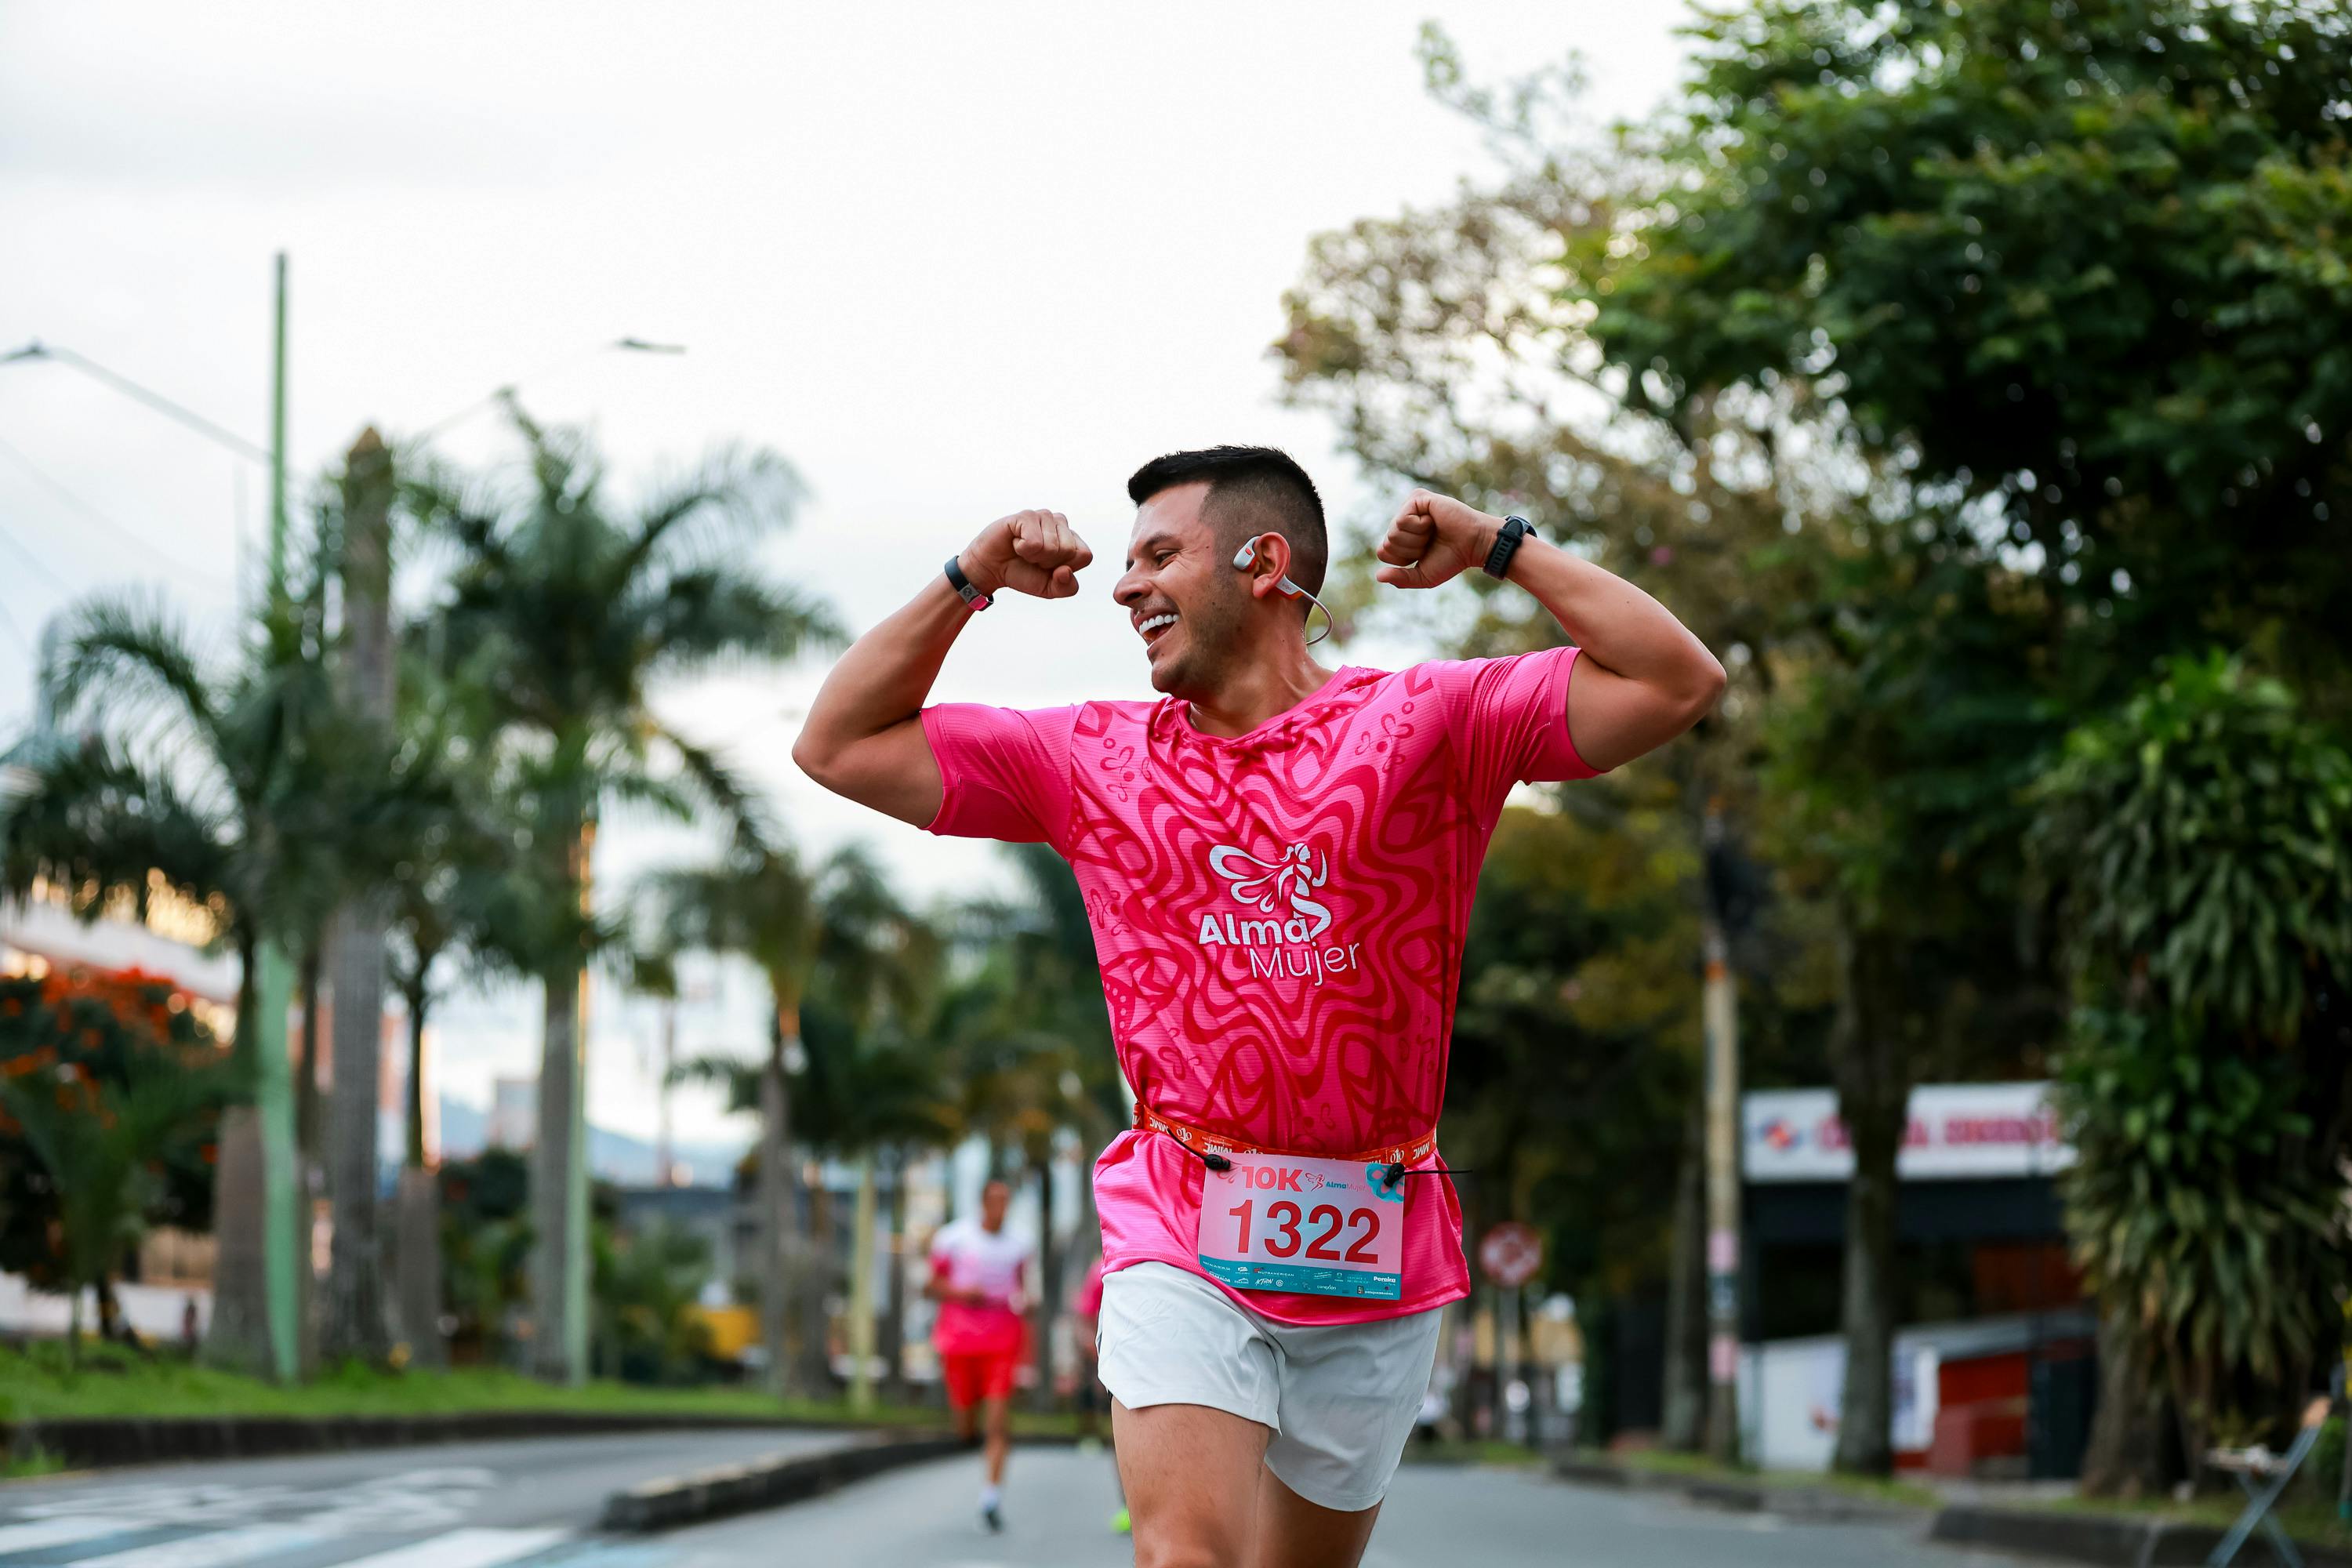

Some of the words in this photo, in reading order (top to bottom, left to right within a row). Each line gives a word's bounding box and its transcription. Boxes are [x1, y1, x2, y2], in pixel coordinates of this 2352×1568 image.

[1199, 913, 1312, 946] Alma
[1249, 941, 1360, 986] Mujer
[1242, 1166, 1303, 1192] 10K
[1229, 1200, 1381, 1264] 1322
